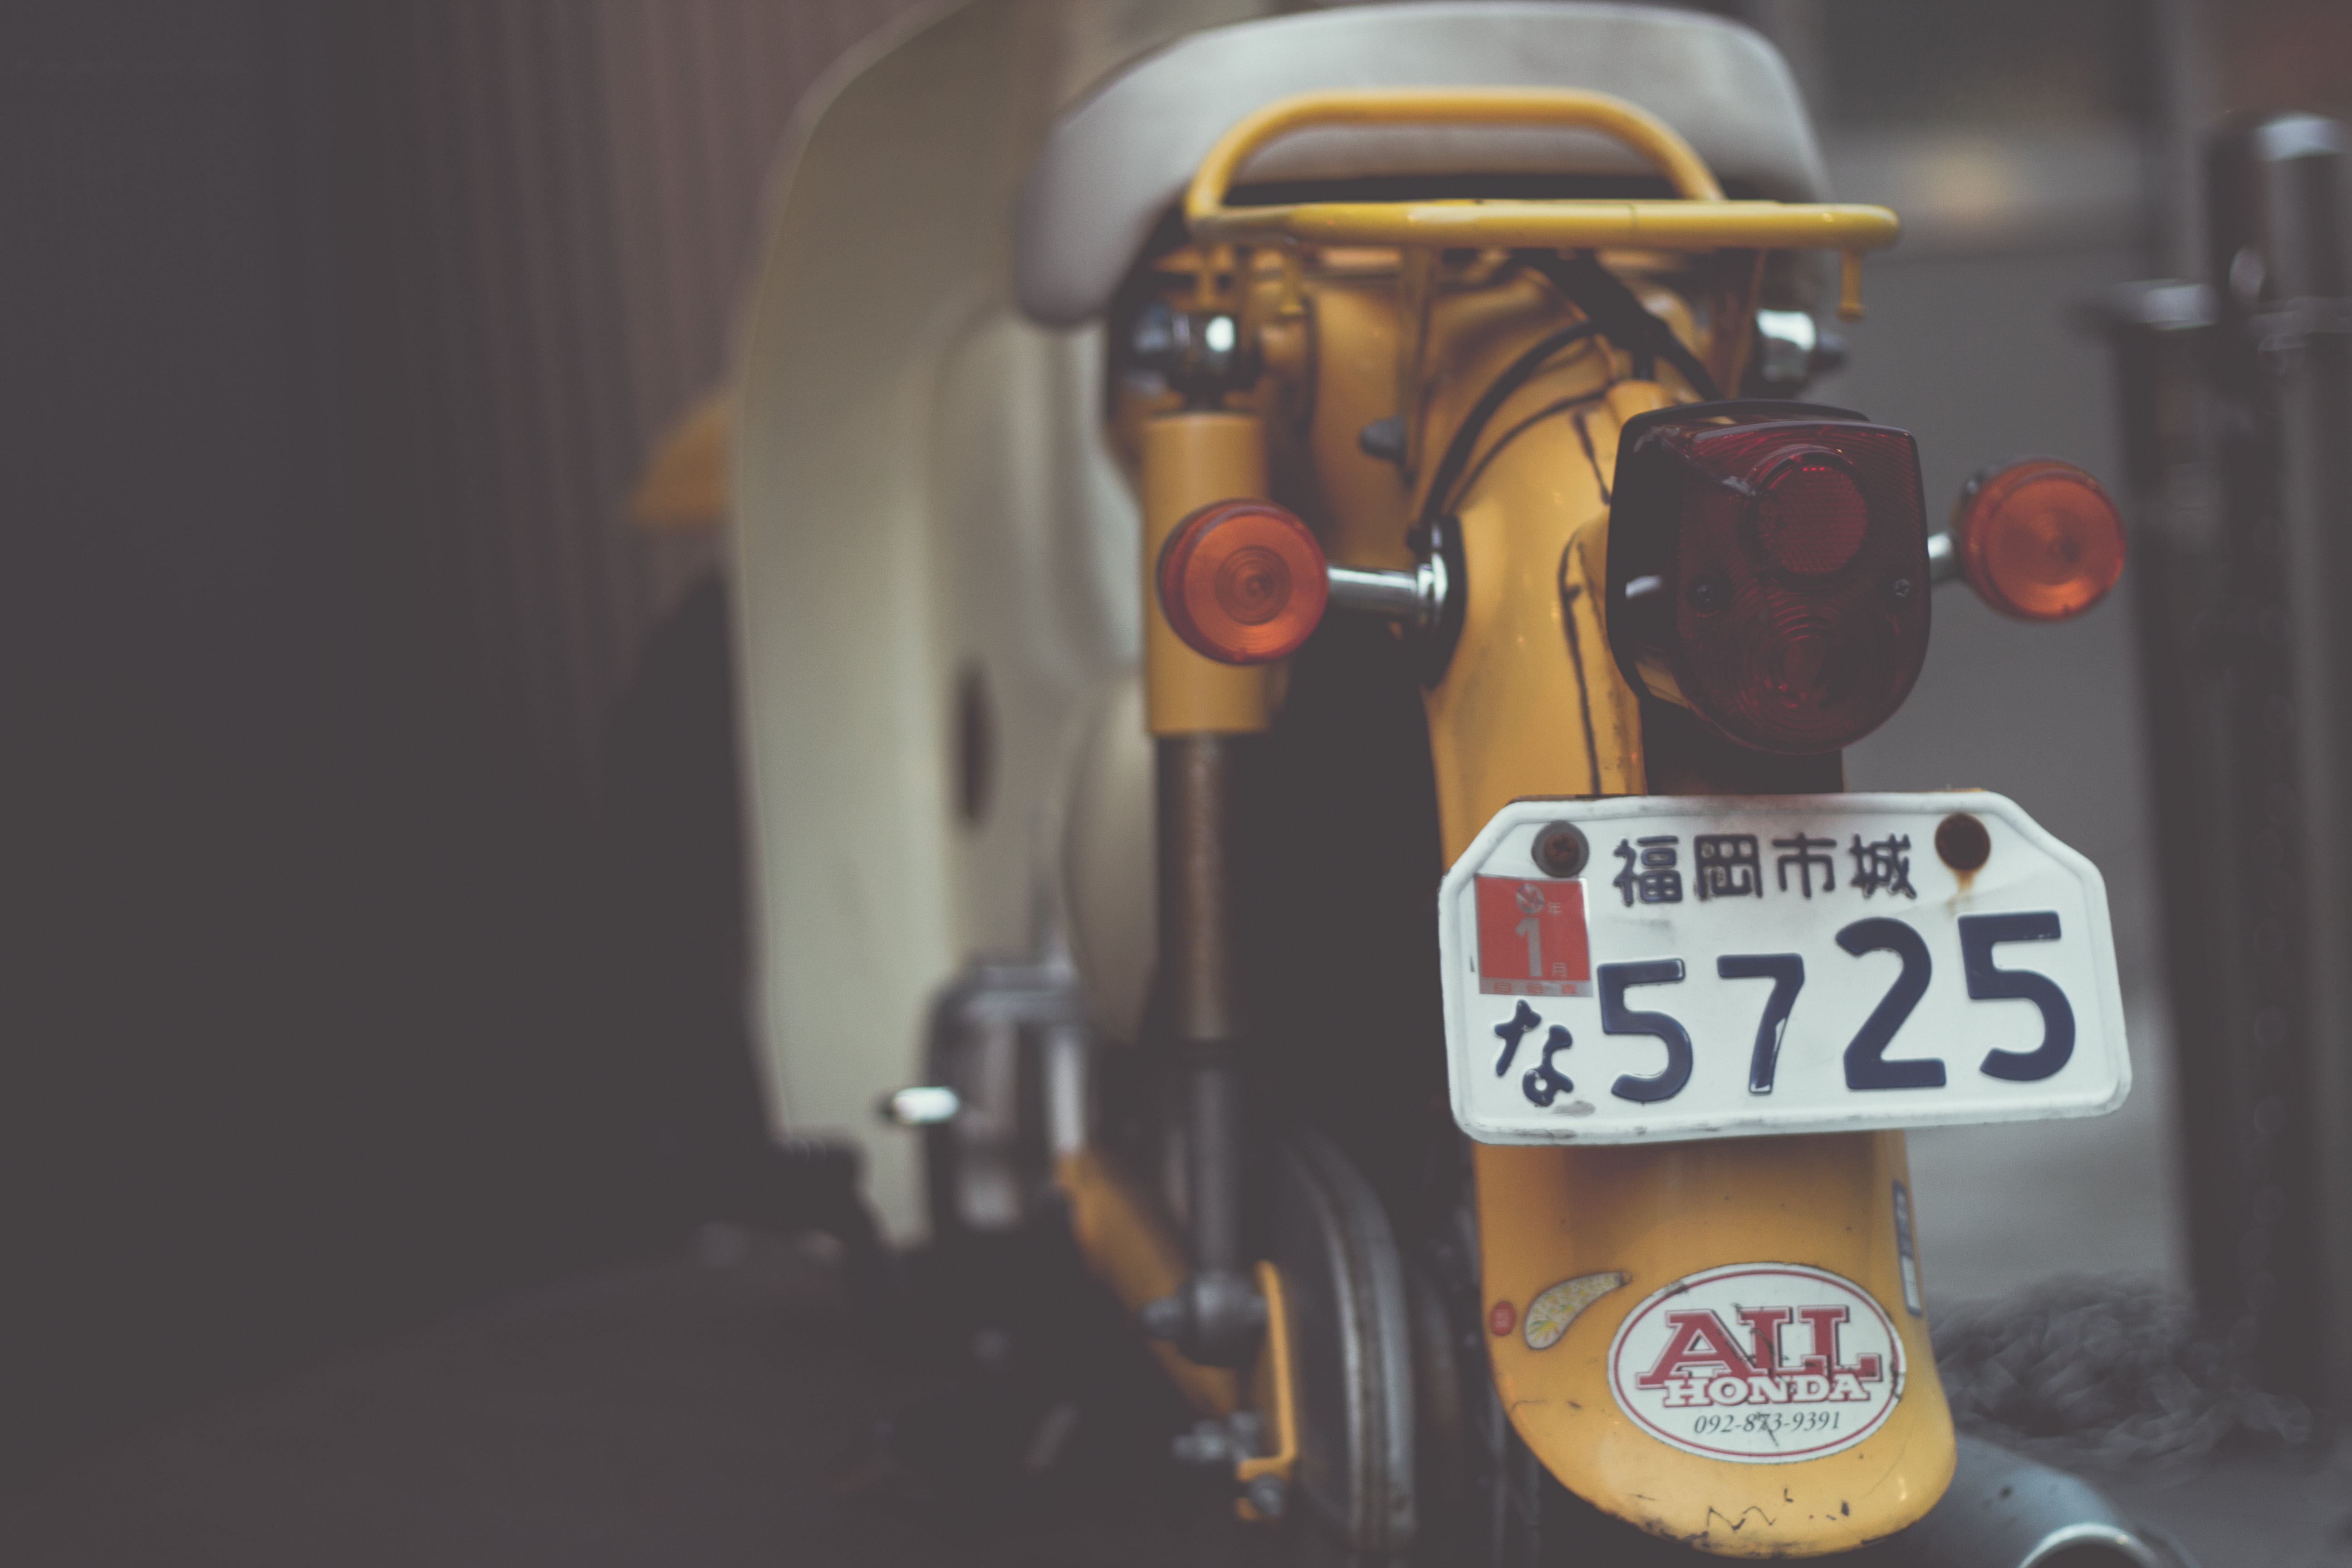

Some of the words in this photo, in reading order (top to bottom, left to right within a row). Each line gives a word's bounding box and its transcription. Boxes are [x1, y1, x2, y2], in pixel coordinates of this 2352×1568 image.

[1613, 832, 1917, 907] 福岡市城
[1635, 1305, 1884, 1390] ALL
[1664, 1373, 1870, 1407] HONDA
[1694, 1411, 1841, 1435] 092-873-9391
